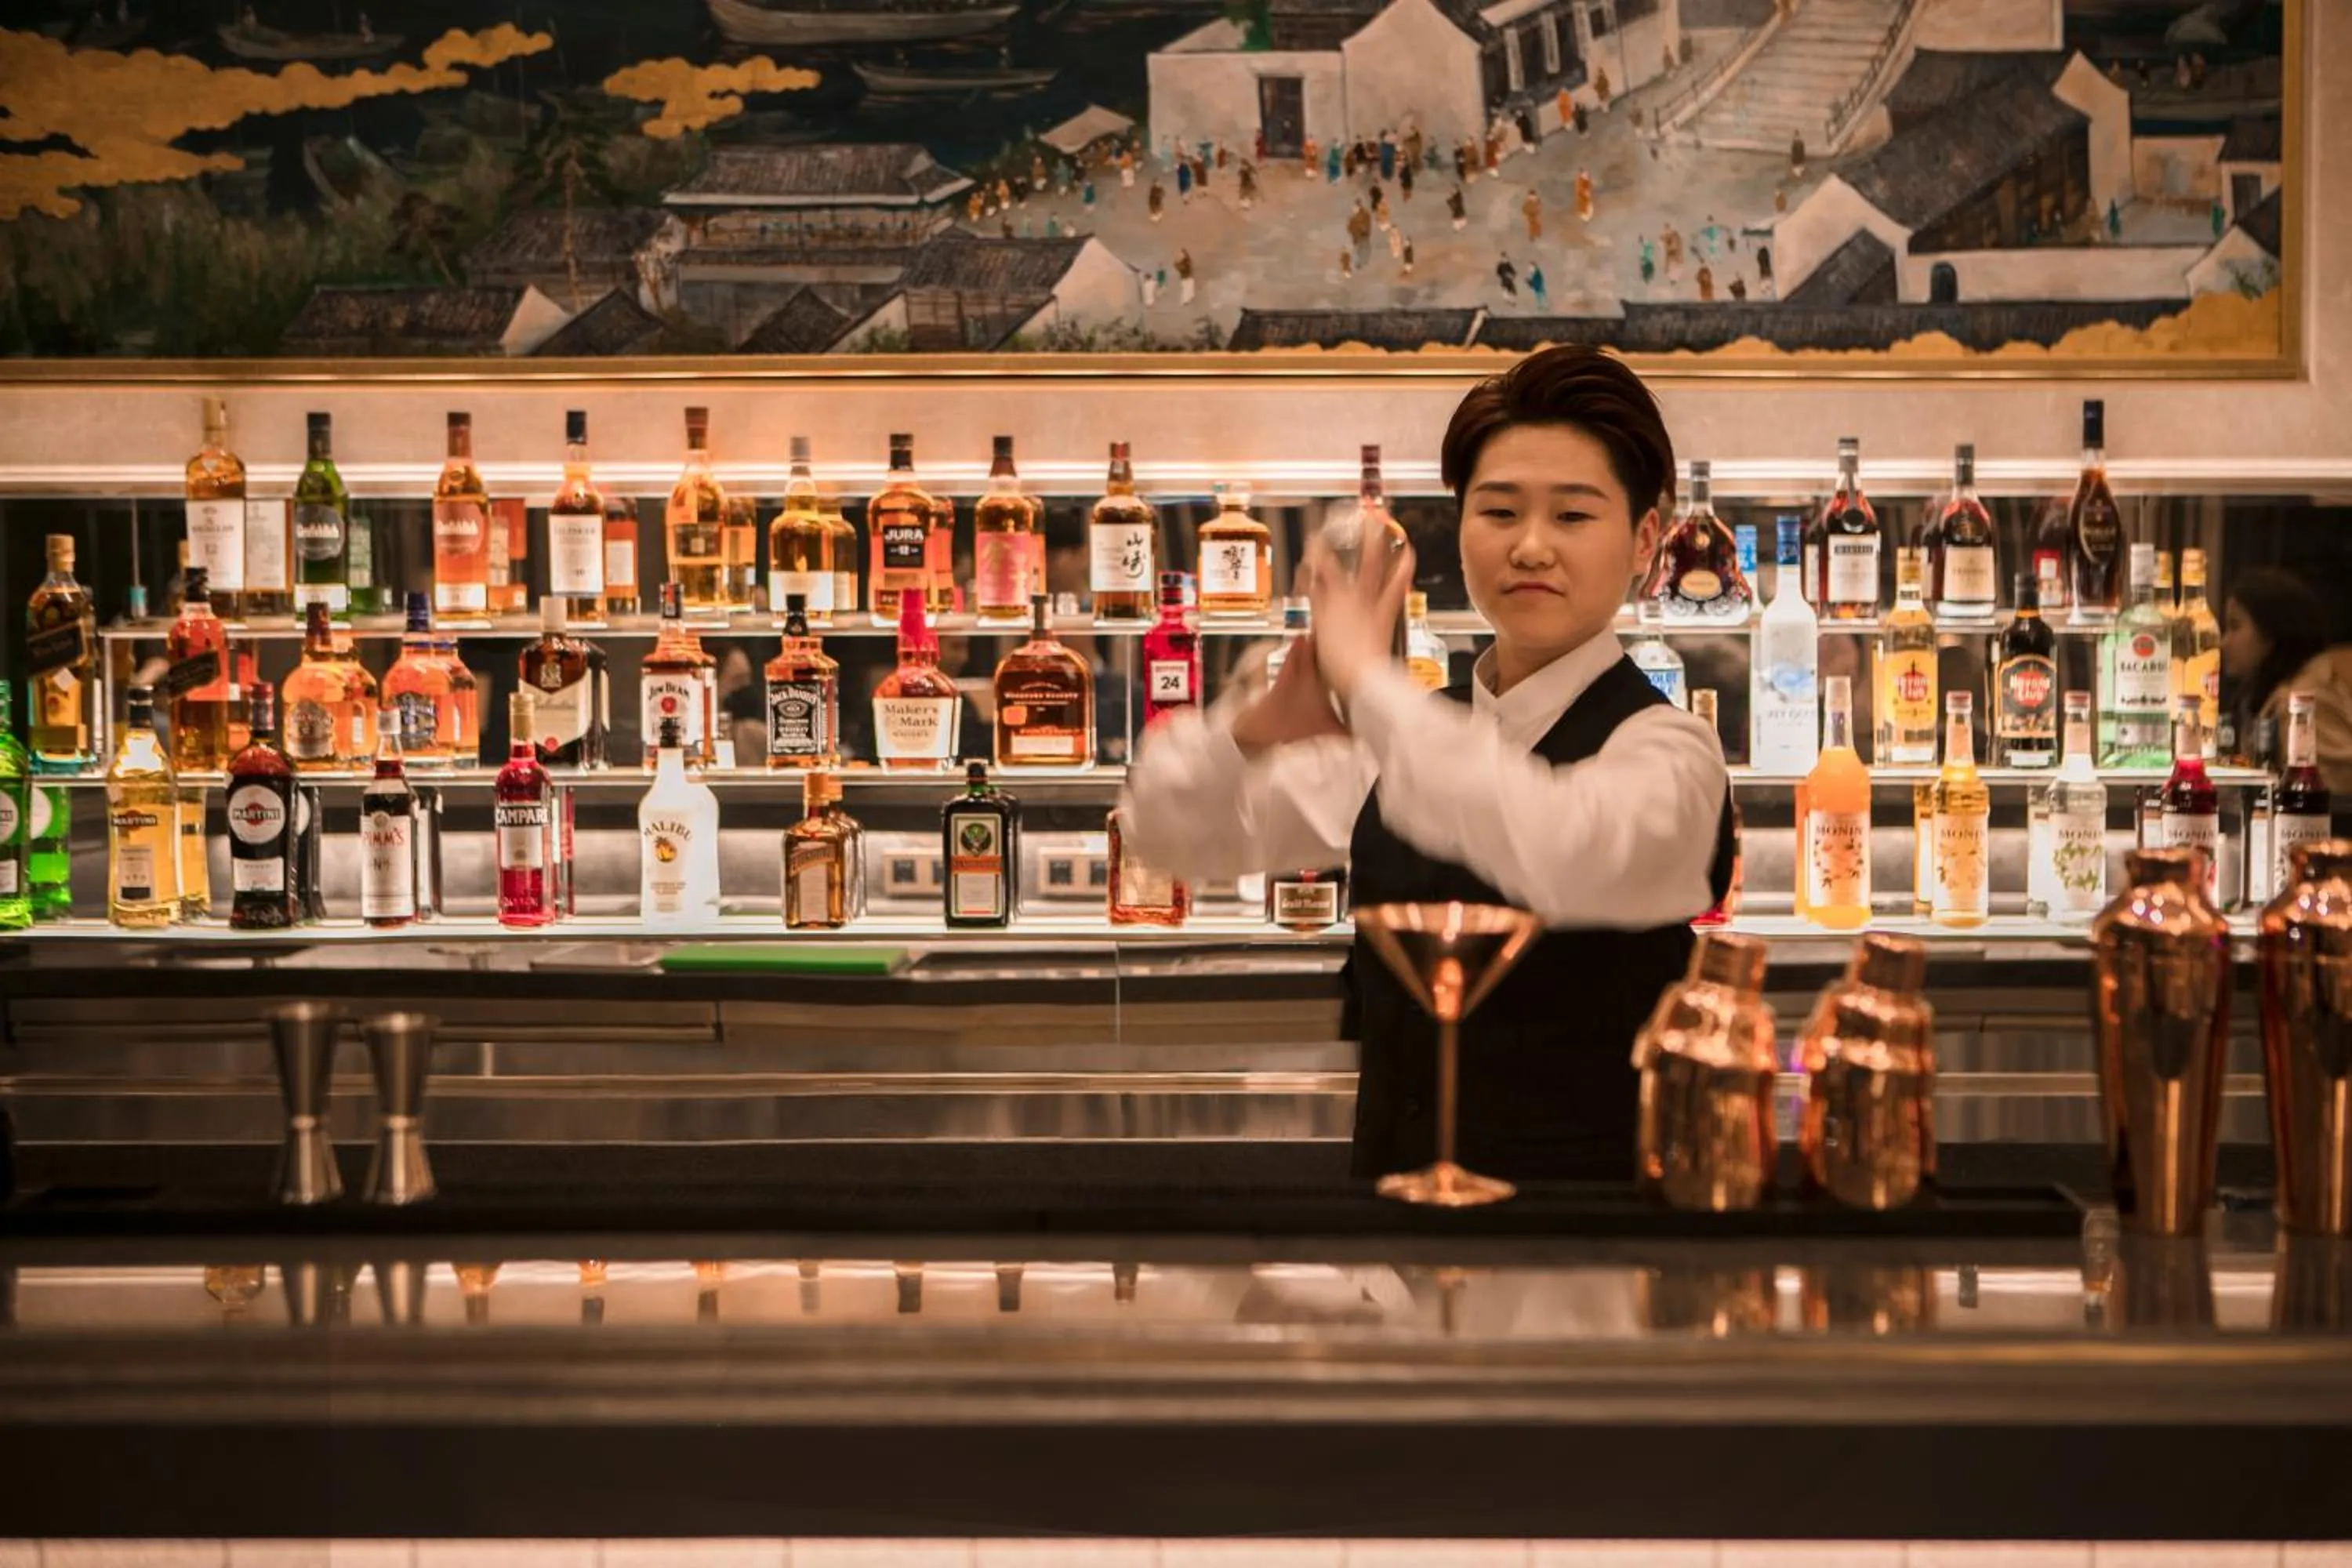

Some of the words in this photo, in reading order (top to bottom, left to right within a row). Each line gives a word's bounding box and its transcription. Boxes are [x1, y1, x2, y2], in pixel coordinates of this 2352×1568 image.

[884, 528, 925, 542] JURA
[1160, 675, 1180, 690] 24
[770, 691, 789, 706] JACK
[884, 704, 938, 715] Maker's
[900, 716, 938, 728] Mark
[234, 808, 280, 821] MARTINI
[495, 808, 548, 824] CAMPARI
[644, 820, 692, 841] MALIBU
[1817, 826, 1862, 836] MONIN
[2059, 829, 2101, 839] MONIN
